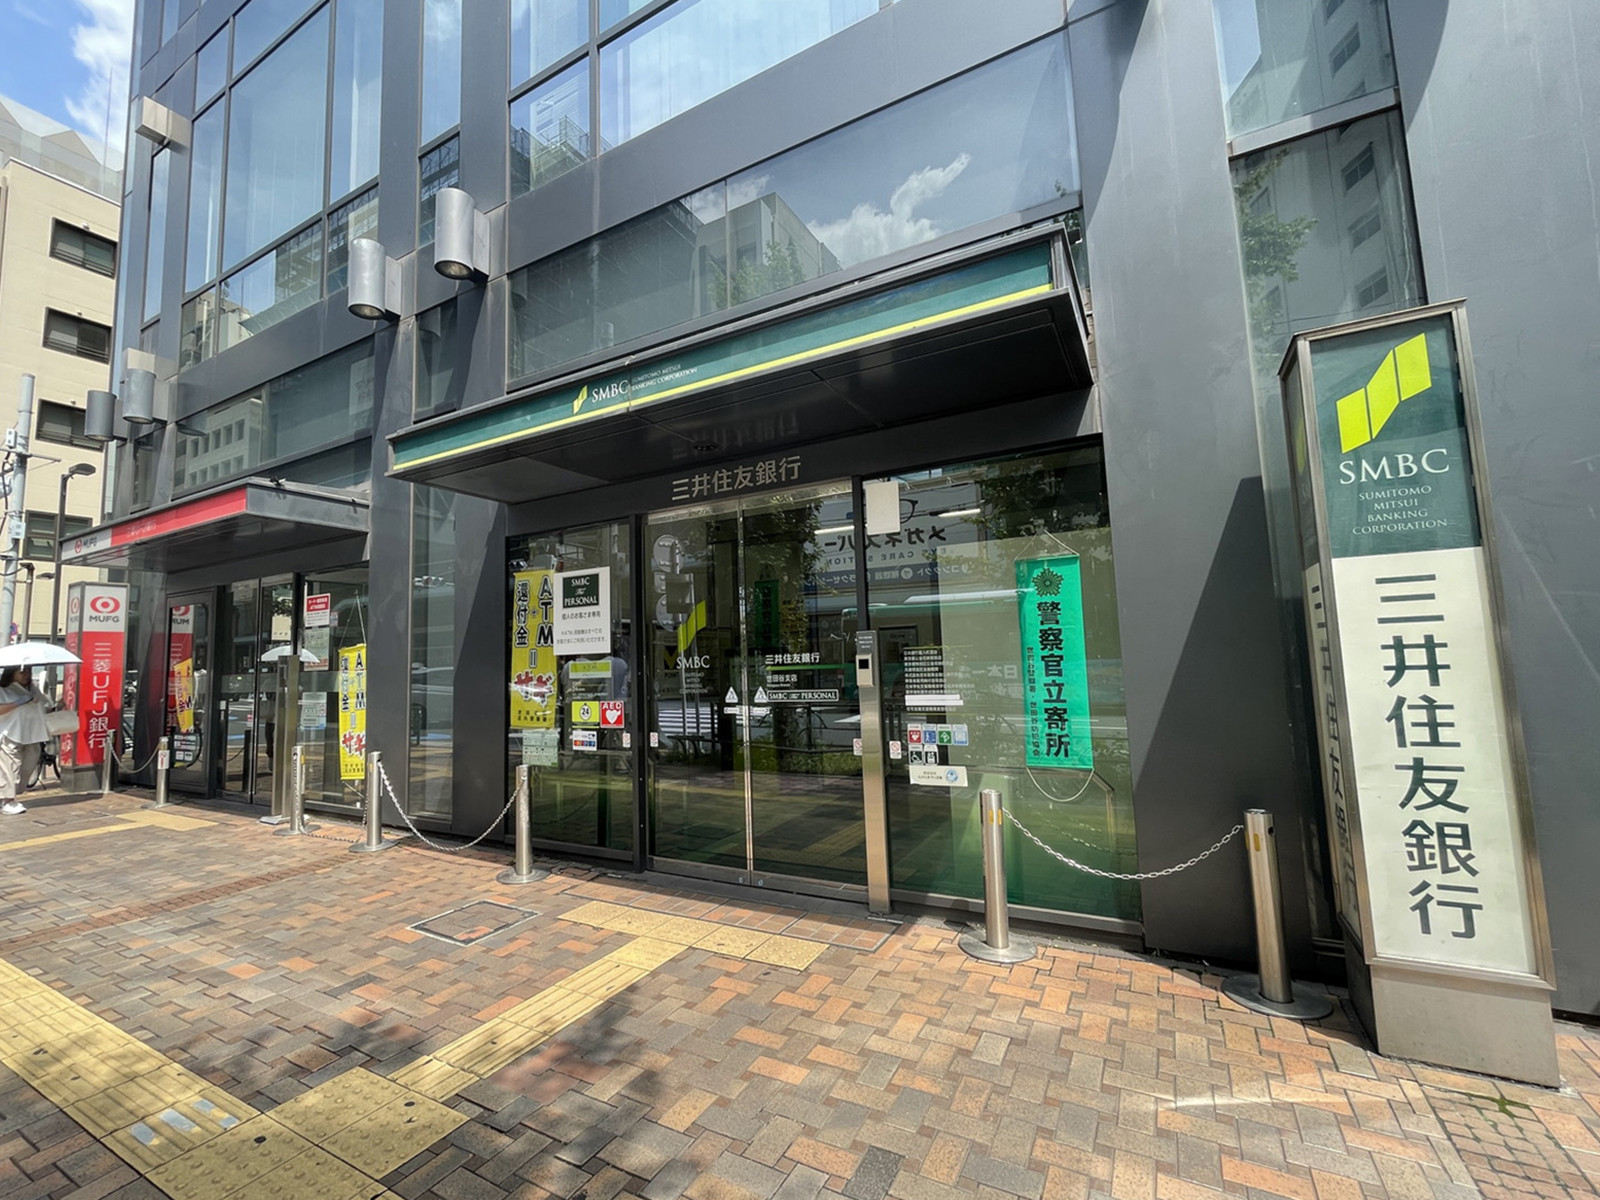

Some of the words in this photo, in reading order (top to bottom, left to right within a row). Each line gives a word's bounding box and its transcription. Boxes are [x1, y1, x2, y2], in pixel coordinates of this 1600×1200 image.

[657, 367, 698, 384] CORPORATION
[662, 364, 682, 376] MITSUI
[592, 380, 629, 403] SMBC
[1338, 448, 1450, 485] SMBC
[671, 455, 801, 500] 三井住友銀行
[1359, 485, 1432, 501] SUMITOMO
[1373, 498, 1418, 510] MITSUI
[1367, 508, 1428, 522] BANKING
[1352, 518, 1448, 535] CORPORATION
[571, 577, 590, 587] SMBC
[564, 595, 598, 607] PERSONAL
[536, 575, 554, 647] ATM
[89, 615, 120, 623] MUFG
[676, 655, 710, 669] SMBC
[765, 652, 820, 665] 三井住友銀行
[1036, 601, 1070, 758] 警察官立寄所
[88, 642, 112, 749] 三菱UFJ銀行
[581, 707, 590, 716] 24
[602, 702, 622, 710] AED
[1375, 573, 1484, 940] 三井住友銀行
